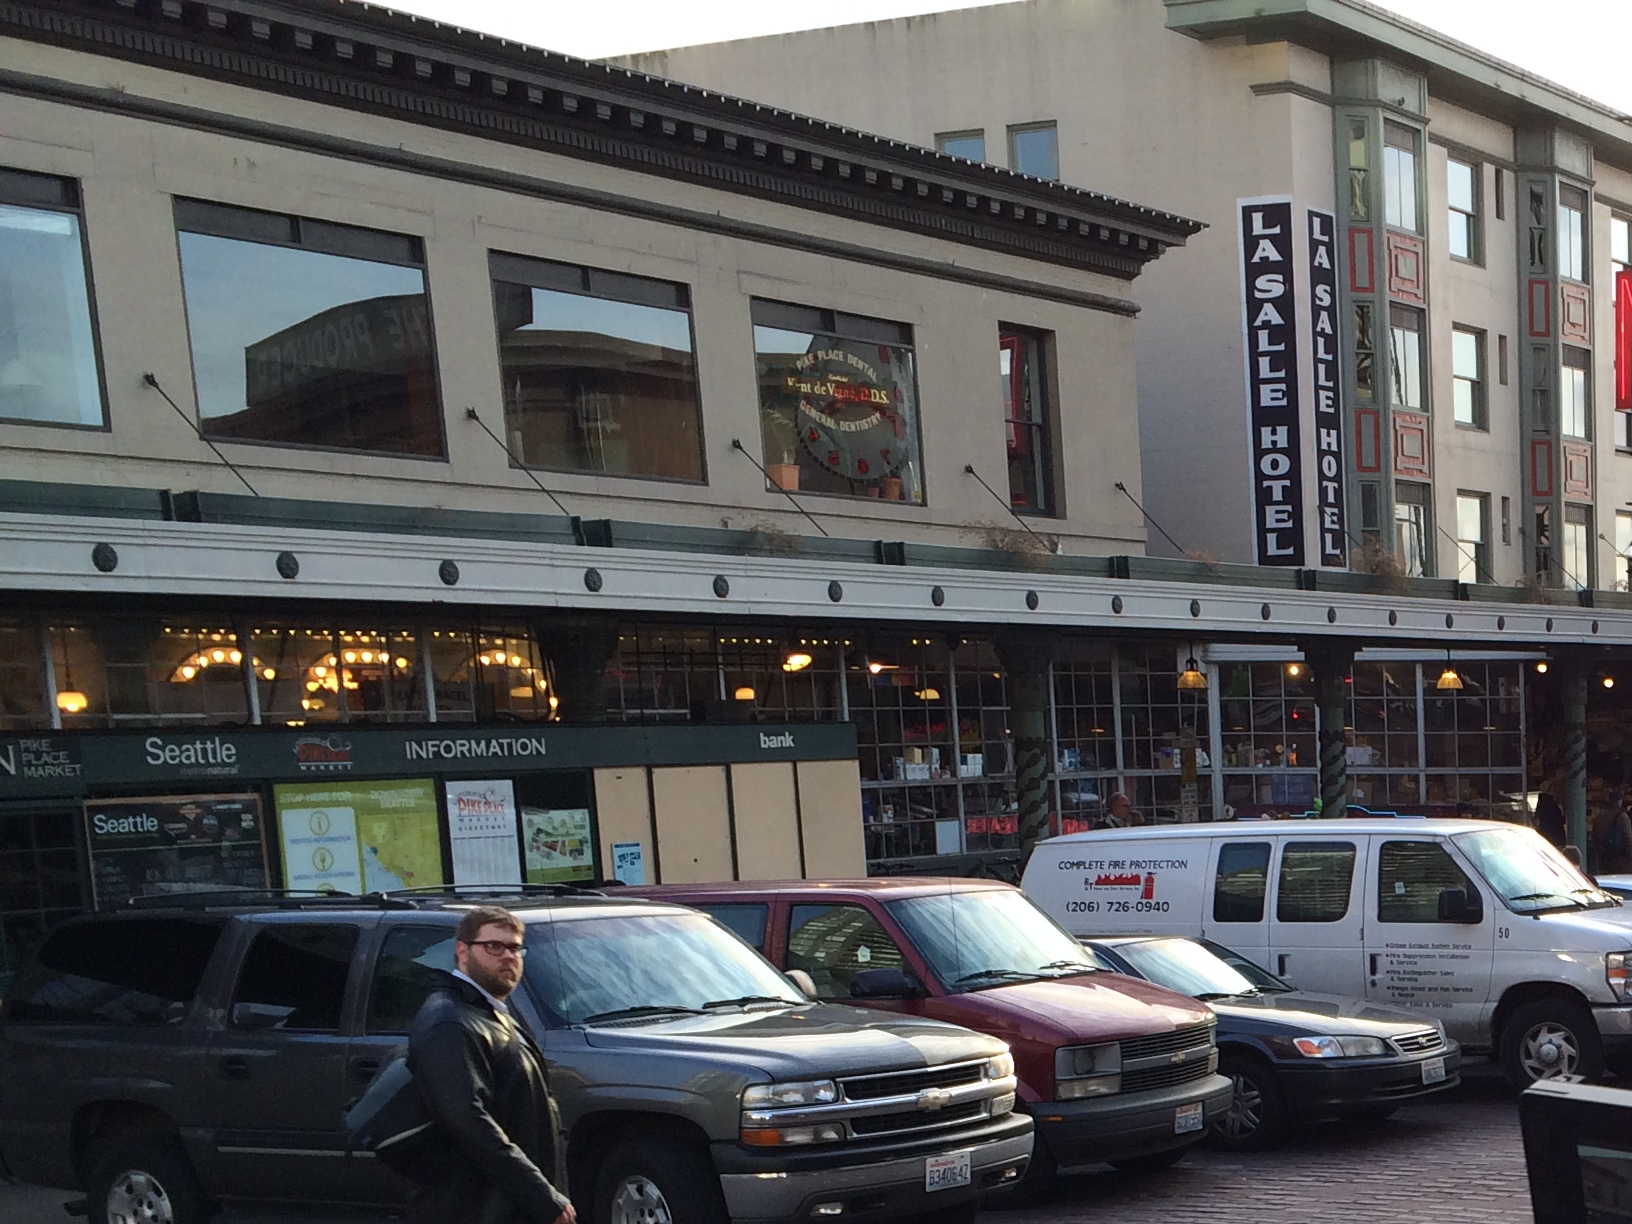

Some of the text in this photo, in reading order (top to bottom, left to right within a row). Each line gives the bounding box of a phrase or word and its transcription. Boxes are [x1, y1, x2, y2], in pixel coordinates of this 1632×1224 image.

[796, 353, 815, 371] PIKE
[817, 349, 844, 361] PLACE
[847, 353, 878, 382] DENTAL
[1250, 211, 1295, 556] LA SALLE HOTEL
[1312, 215, 1340, 555] LA SALLE HOTEL
[800, 400, 881, 432] GENERAL DENTISTRY
[18, 738, 53, 752] PIKE
[405, 737, 546, 760] INFORMATION
[760, 732, 795, 748] bank
[21, 751, 71, 765] PLACE
[146, 737, 236, 765] Seattle
[23, 764, 83, 779] MARKET
[93, 812, 159, 835] Seattle
[1058, 859, 1188, 870] COMPLETE FIRE PROTECTION
[1066, 901, 1170, 913] (206) 726-0940
[1498, 927, 1510, 938] 50
